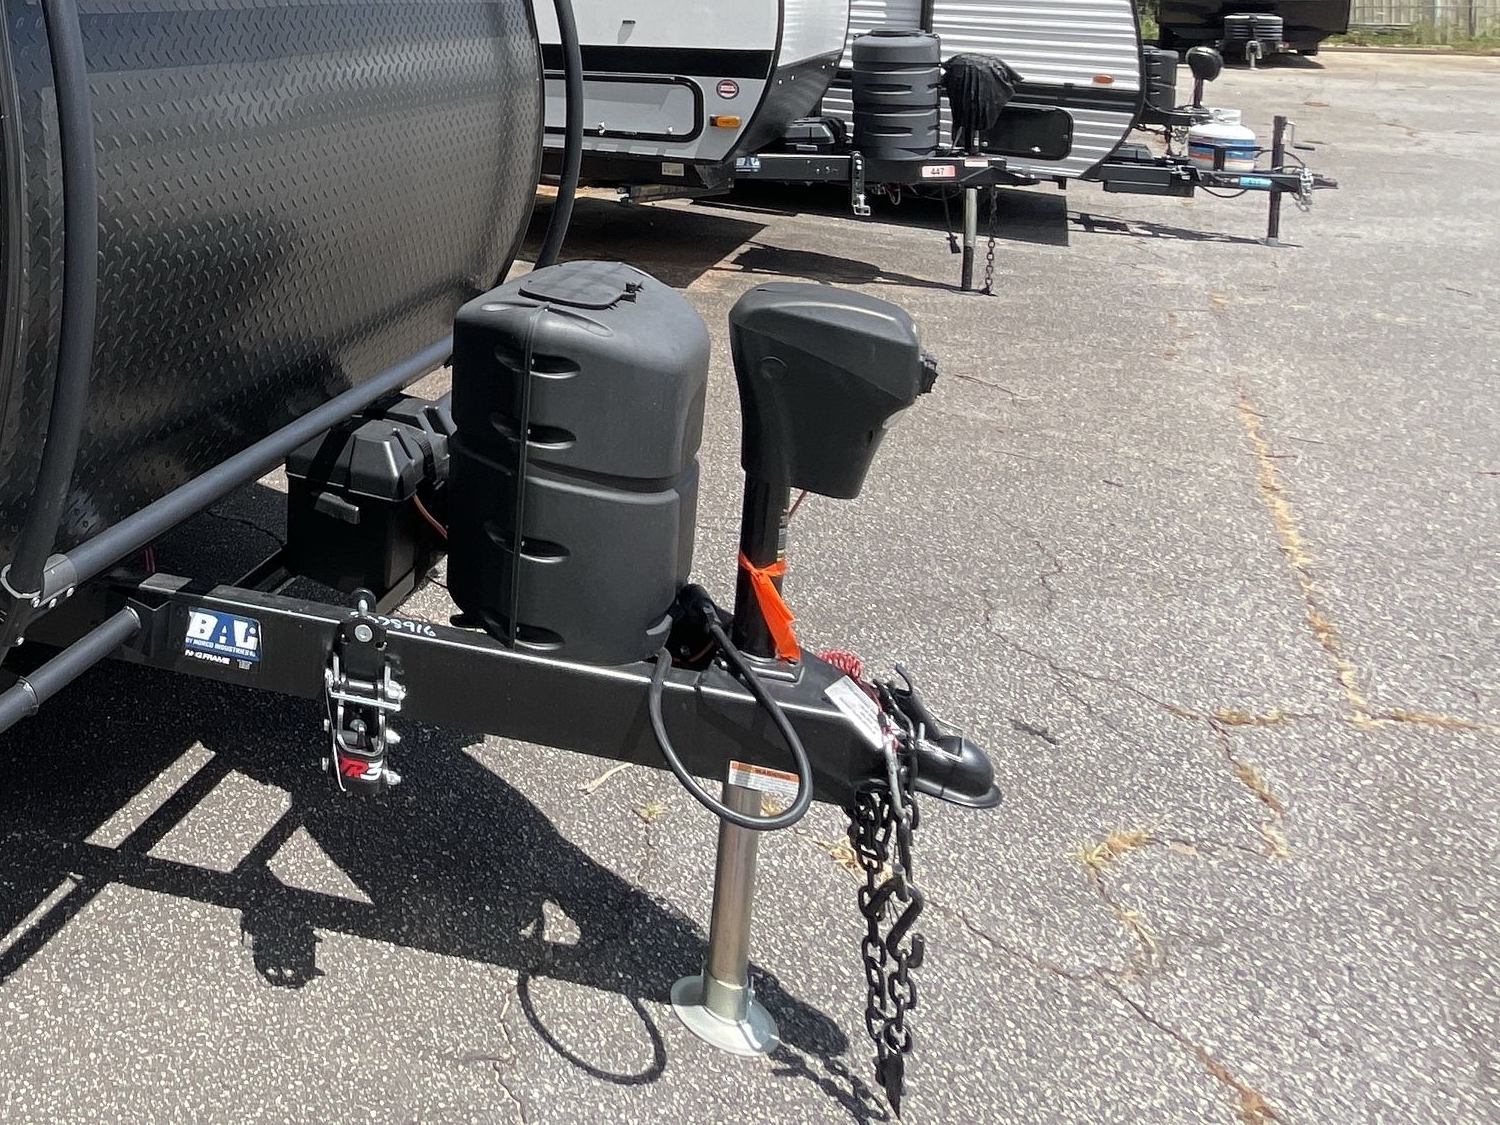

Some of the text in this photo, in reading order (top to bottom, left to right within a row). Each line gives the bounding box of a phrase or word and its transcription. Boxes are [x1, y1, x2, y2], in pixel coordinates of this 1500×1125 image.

[186, 611, 258, 650] BAL
[193, 638, 214, 648] NORCO
[214, 642, 250, 656] INDUSTRIES
[202, 652, 231, 665] FRAME
